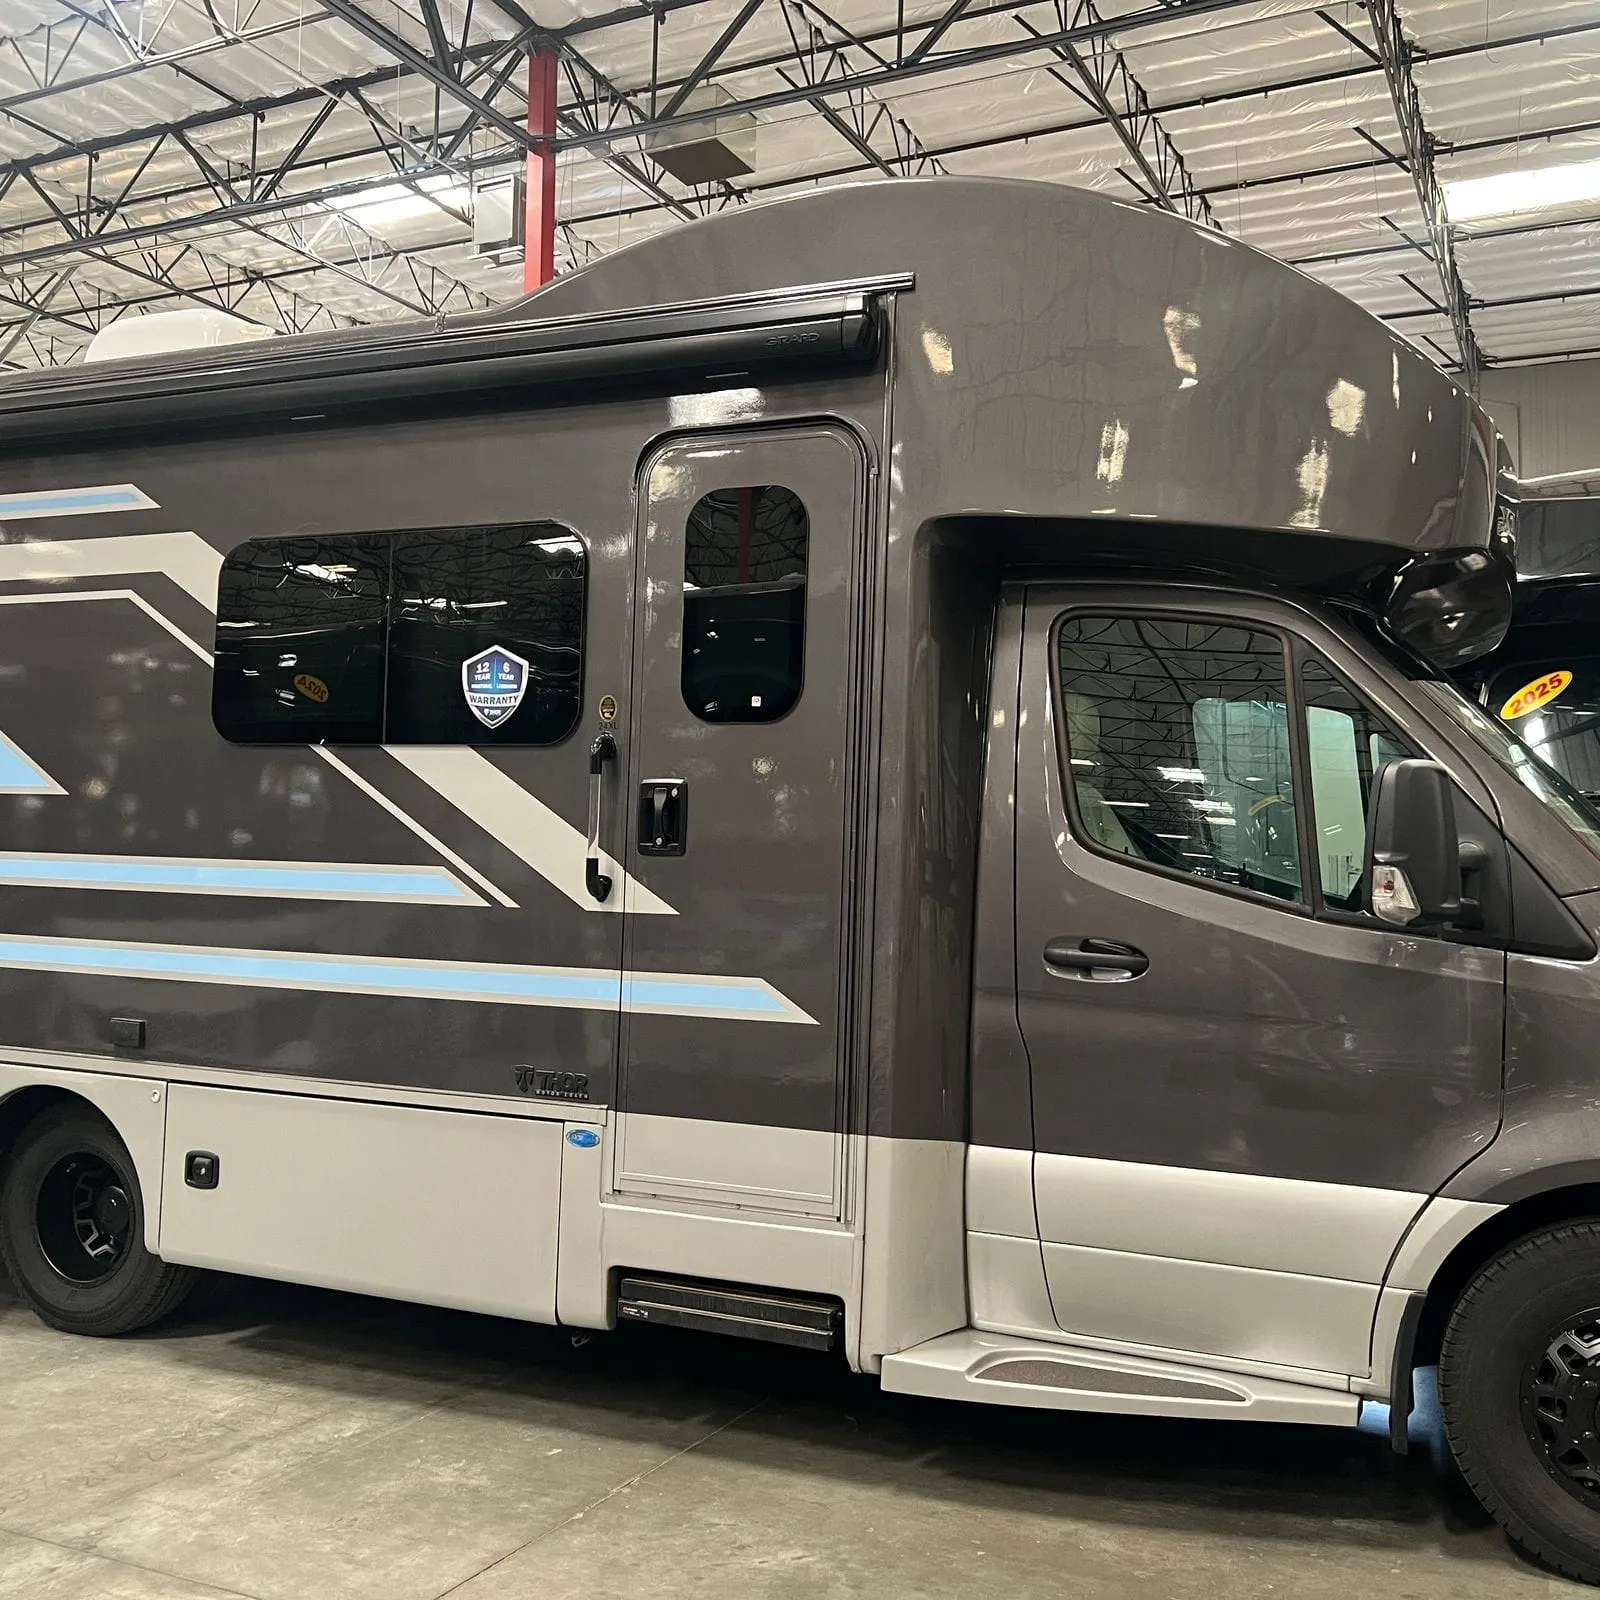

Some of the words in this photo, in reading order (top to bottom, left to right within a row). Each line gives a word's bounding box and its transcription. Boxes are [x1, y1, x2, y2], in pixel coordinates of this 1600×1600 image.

[475, 661, 490, 673] 12
[503, 662, 510, 673] 6
[474, 672, 491, 681] YEAR
[498, 672, 515, 681] YEAR
[1509, 673, 1563, 715] 2025
[469, 695, 519, 705] WARRANTY
[535, 1069, 590, 1095] THOR
